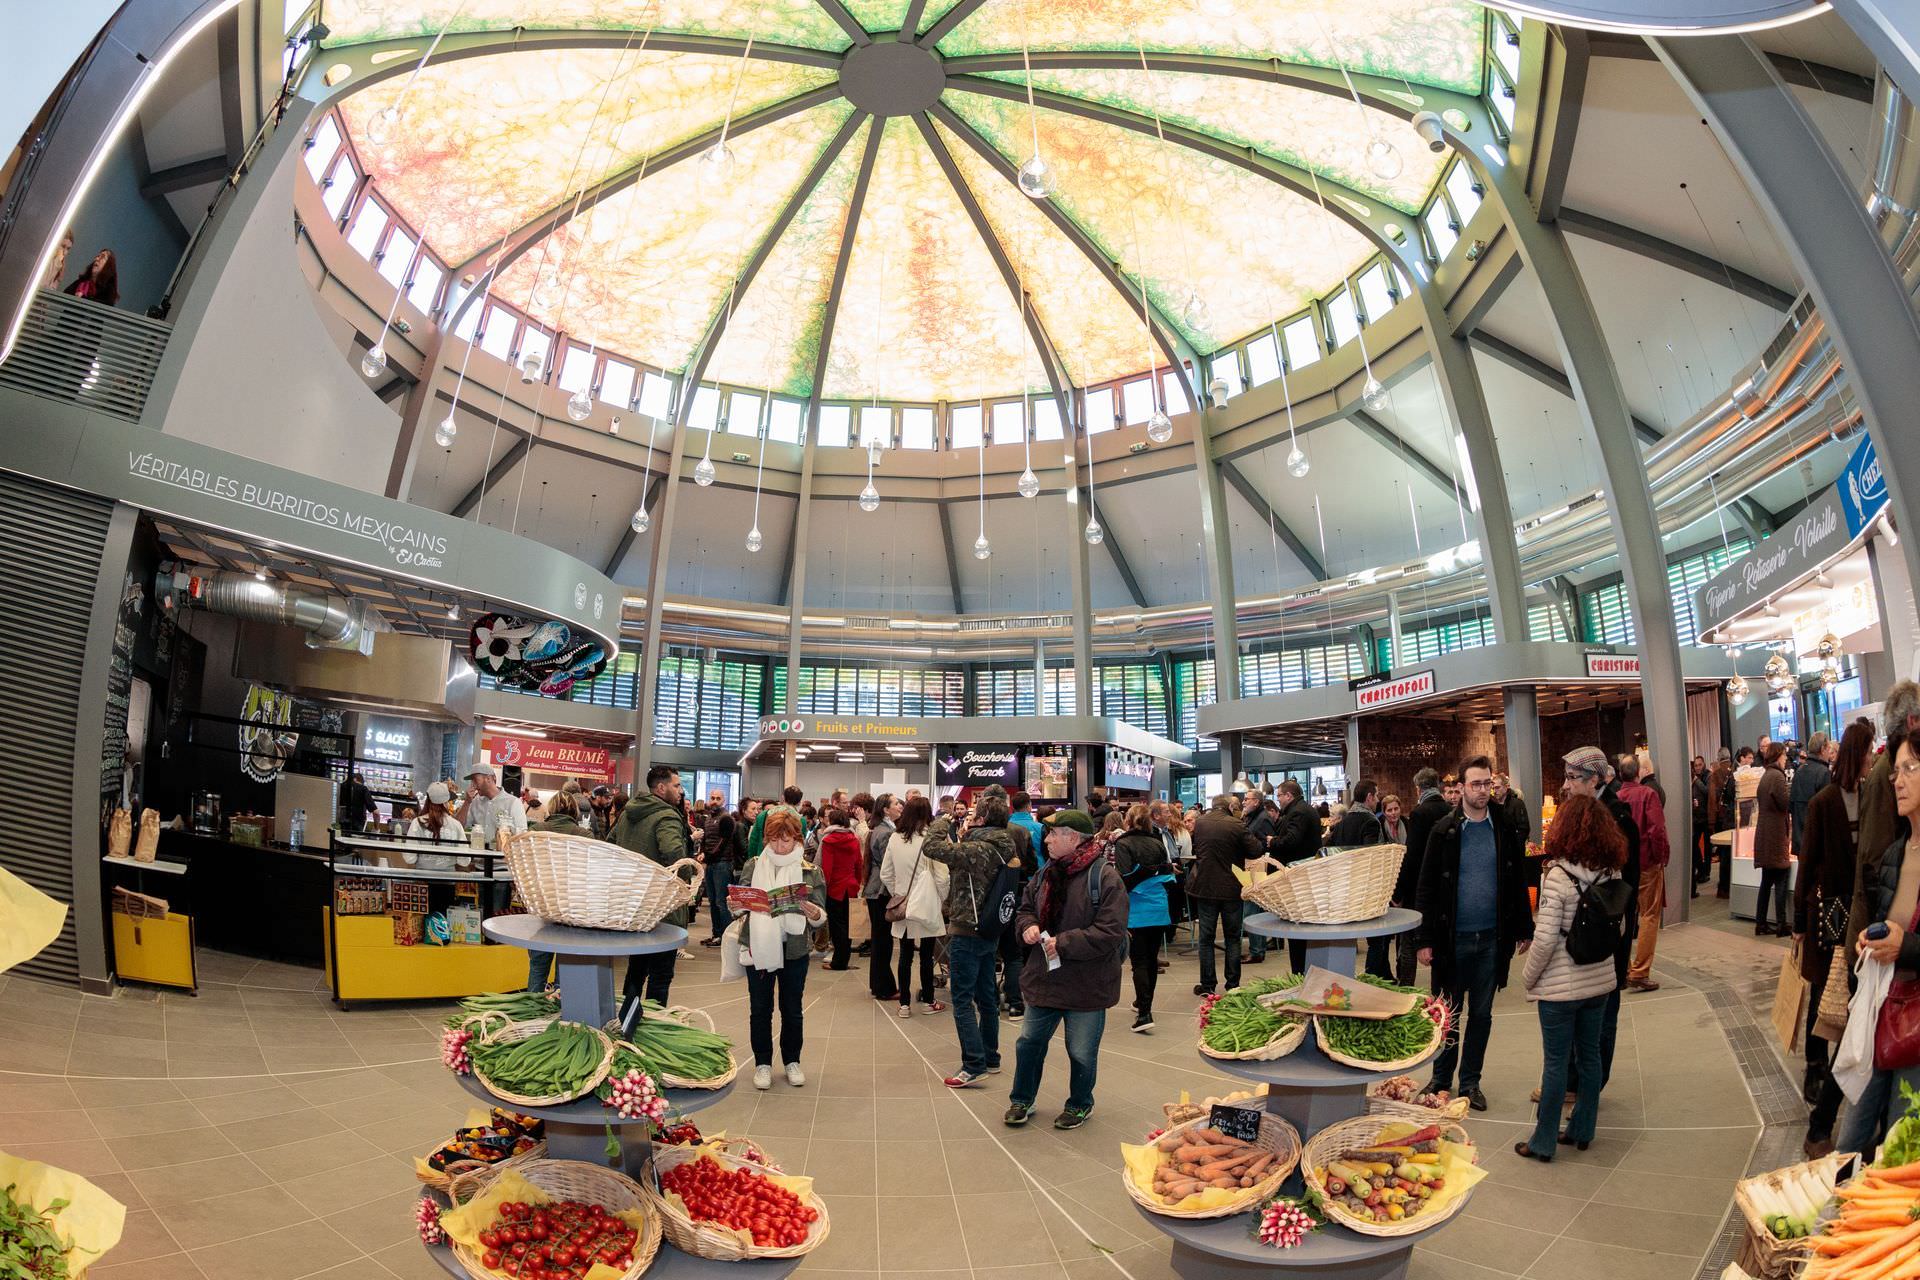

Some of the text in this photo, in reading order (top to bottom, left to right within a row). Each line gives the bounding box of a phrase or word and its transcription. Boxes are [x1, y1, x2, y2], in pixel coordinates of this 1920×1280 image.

[129, 451, 448, 554] VÉRITABLES BURRITOS MEXICAINS
[396, 549, 413, 564] El
[413, 552, 443, 568] Cactus
[1705, 580, 1736, 617] Triperie
[1794, 504, 1837, 558] Volaille
[1360, 677, 1429, 704] CHRISTOFOLI
[815, 721, 918, 736] Fruits et Primeurs
[526, 745, 605, 765] Jean BRUMÉ
[962, 750, 1016, 763] Boucherie
[967, 765, 1006, 778] Franck
